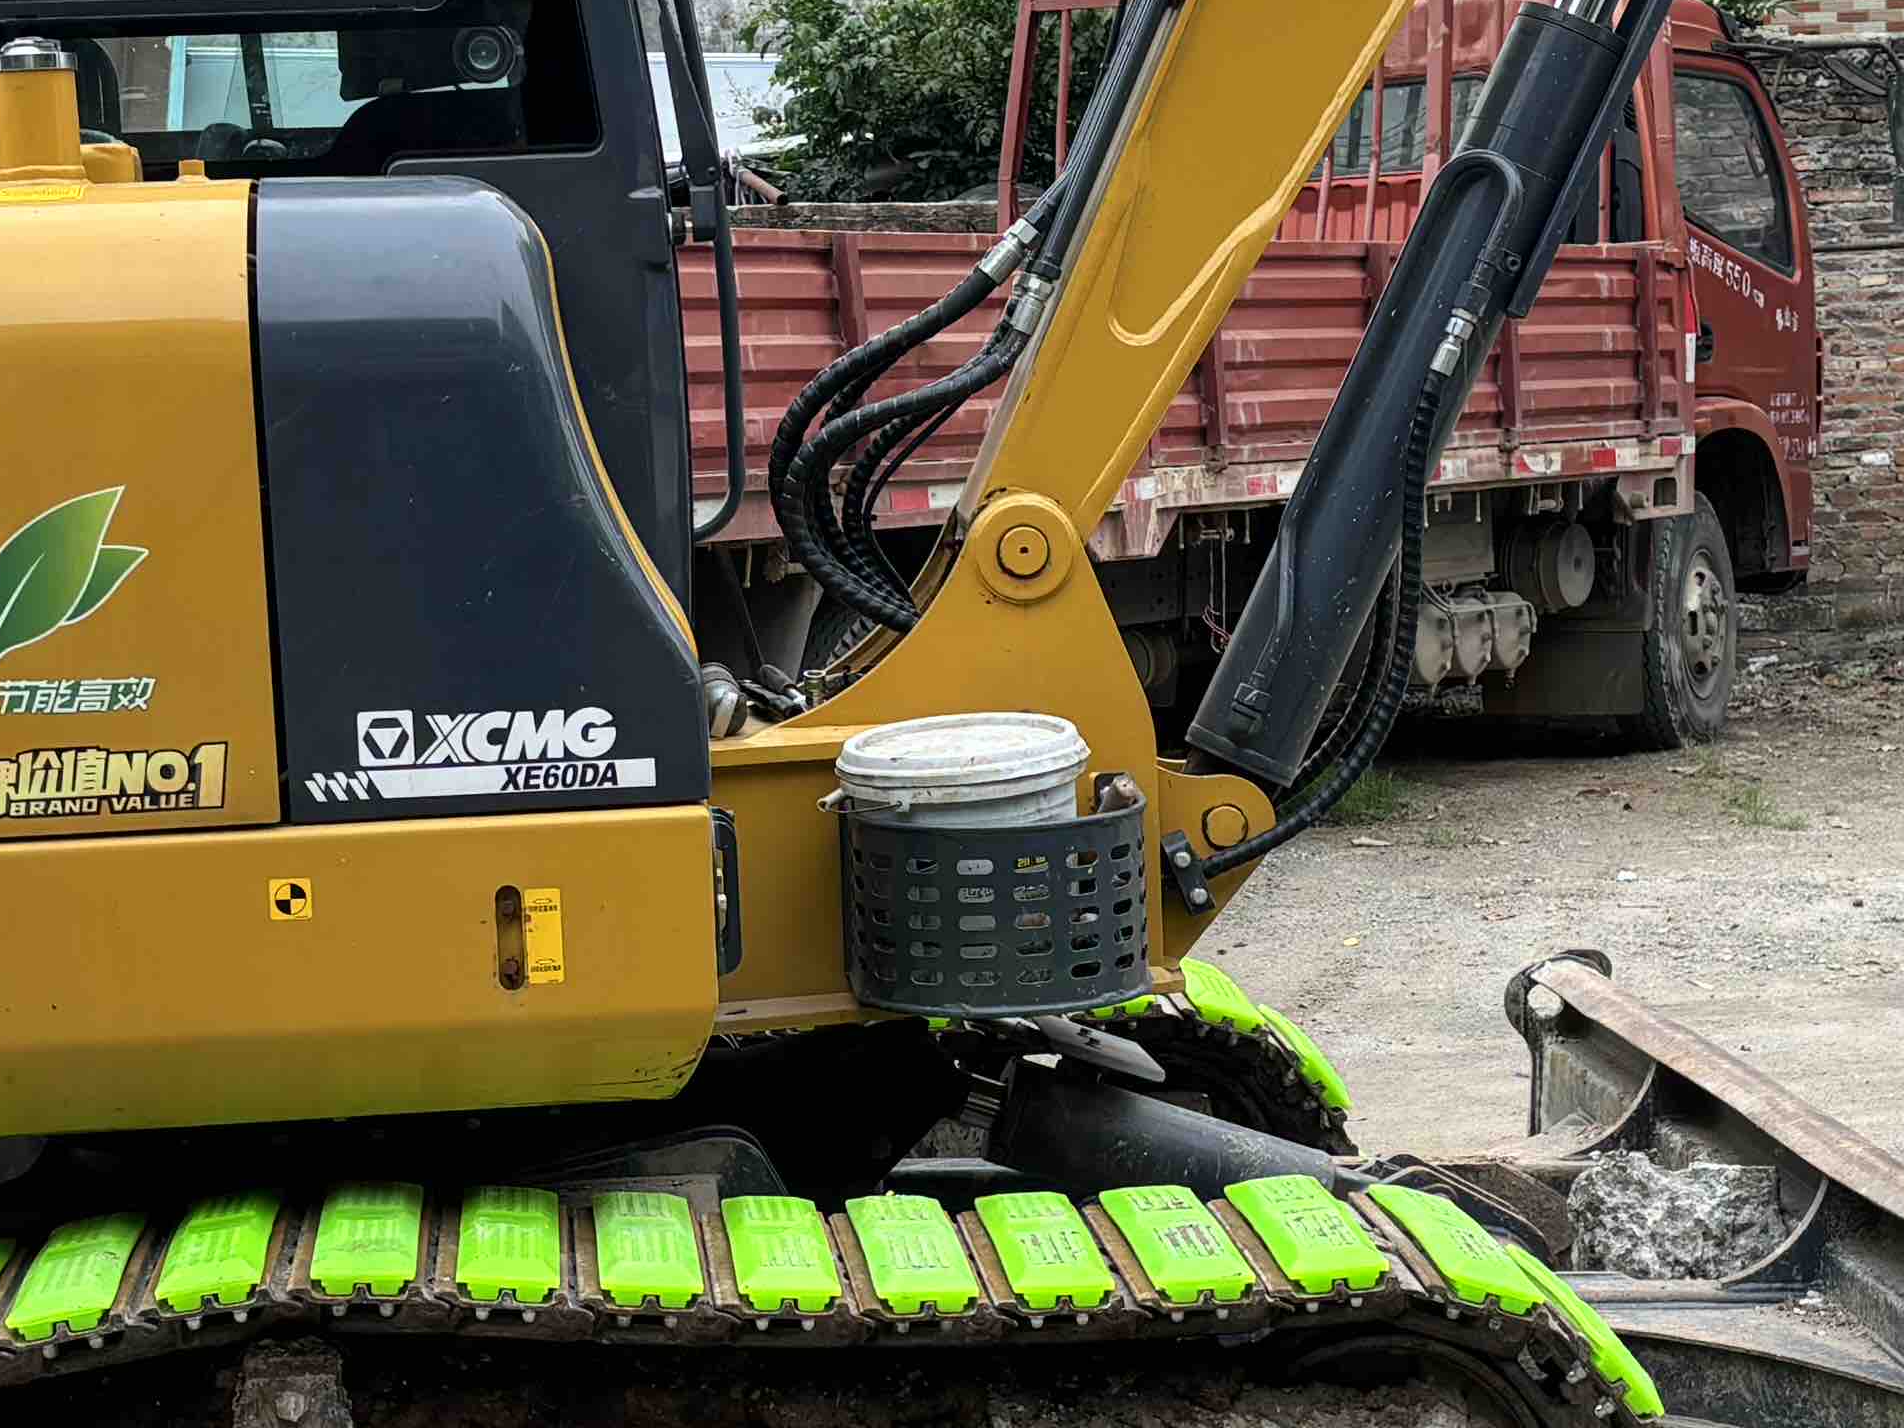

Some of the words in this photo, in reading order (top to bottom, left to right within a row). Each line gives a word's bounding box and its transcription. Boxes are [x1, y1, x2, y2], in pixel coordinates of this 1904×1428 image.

[415, 706, 617, 765] XCMG
[500, 761, 620, 792] XE60DA
[9, 798, 100, 818] BRAND
[110, 793, 195, 813] VALUE
